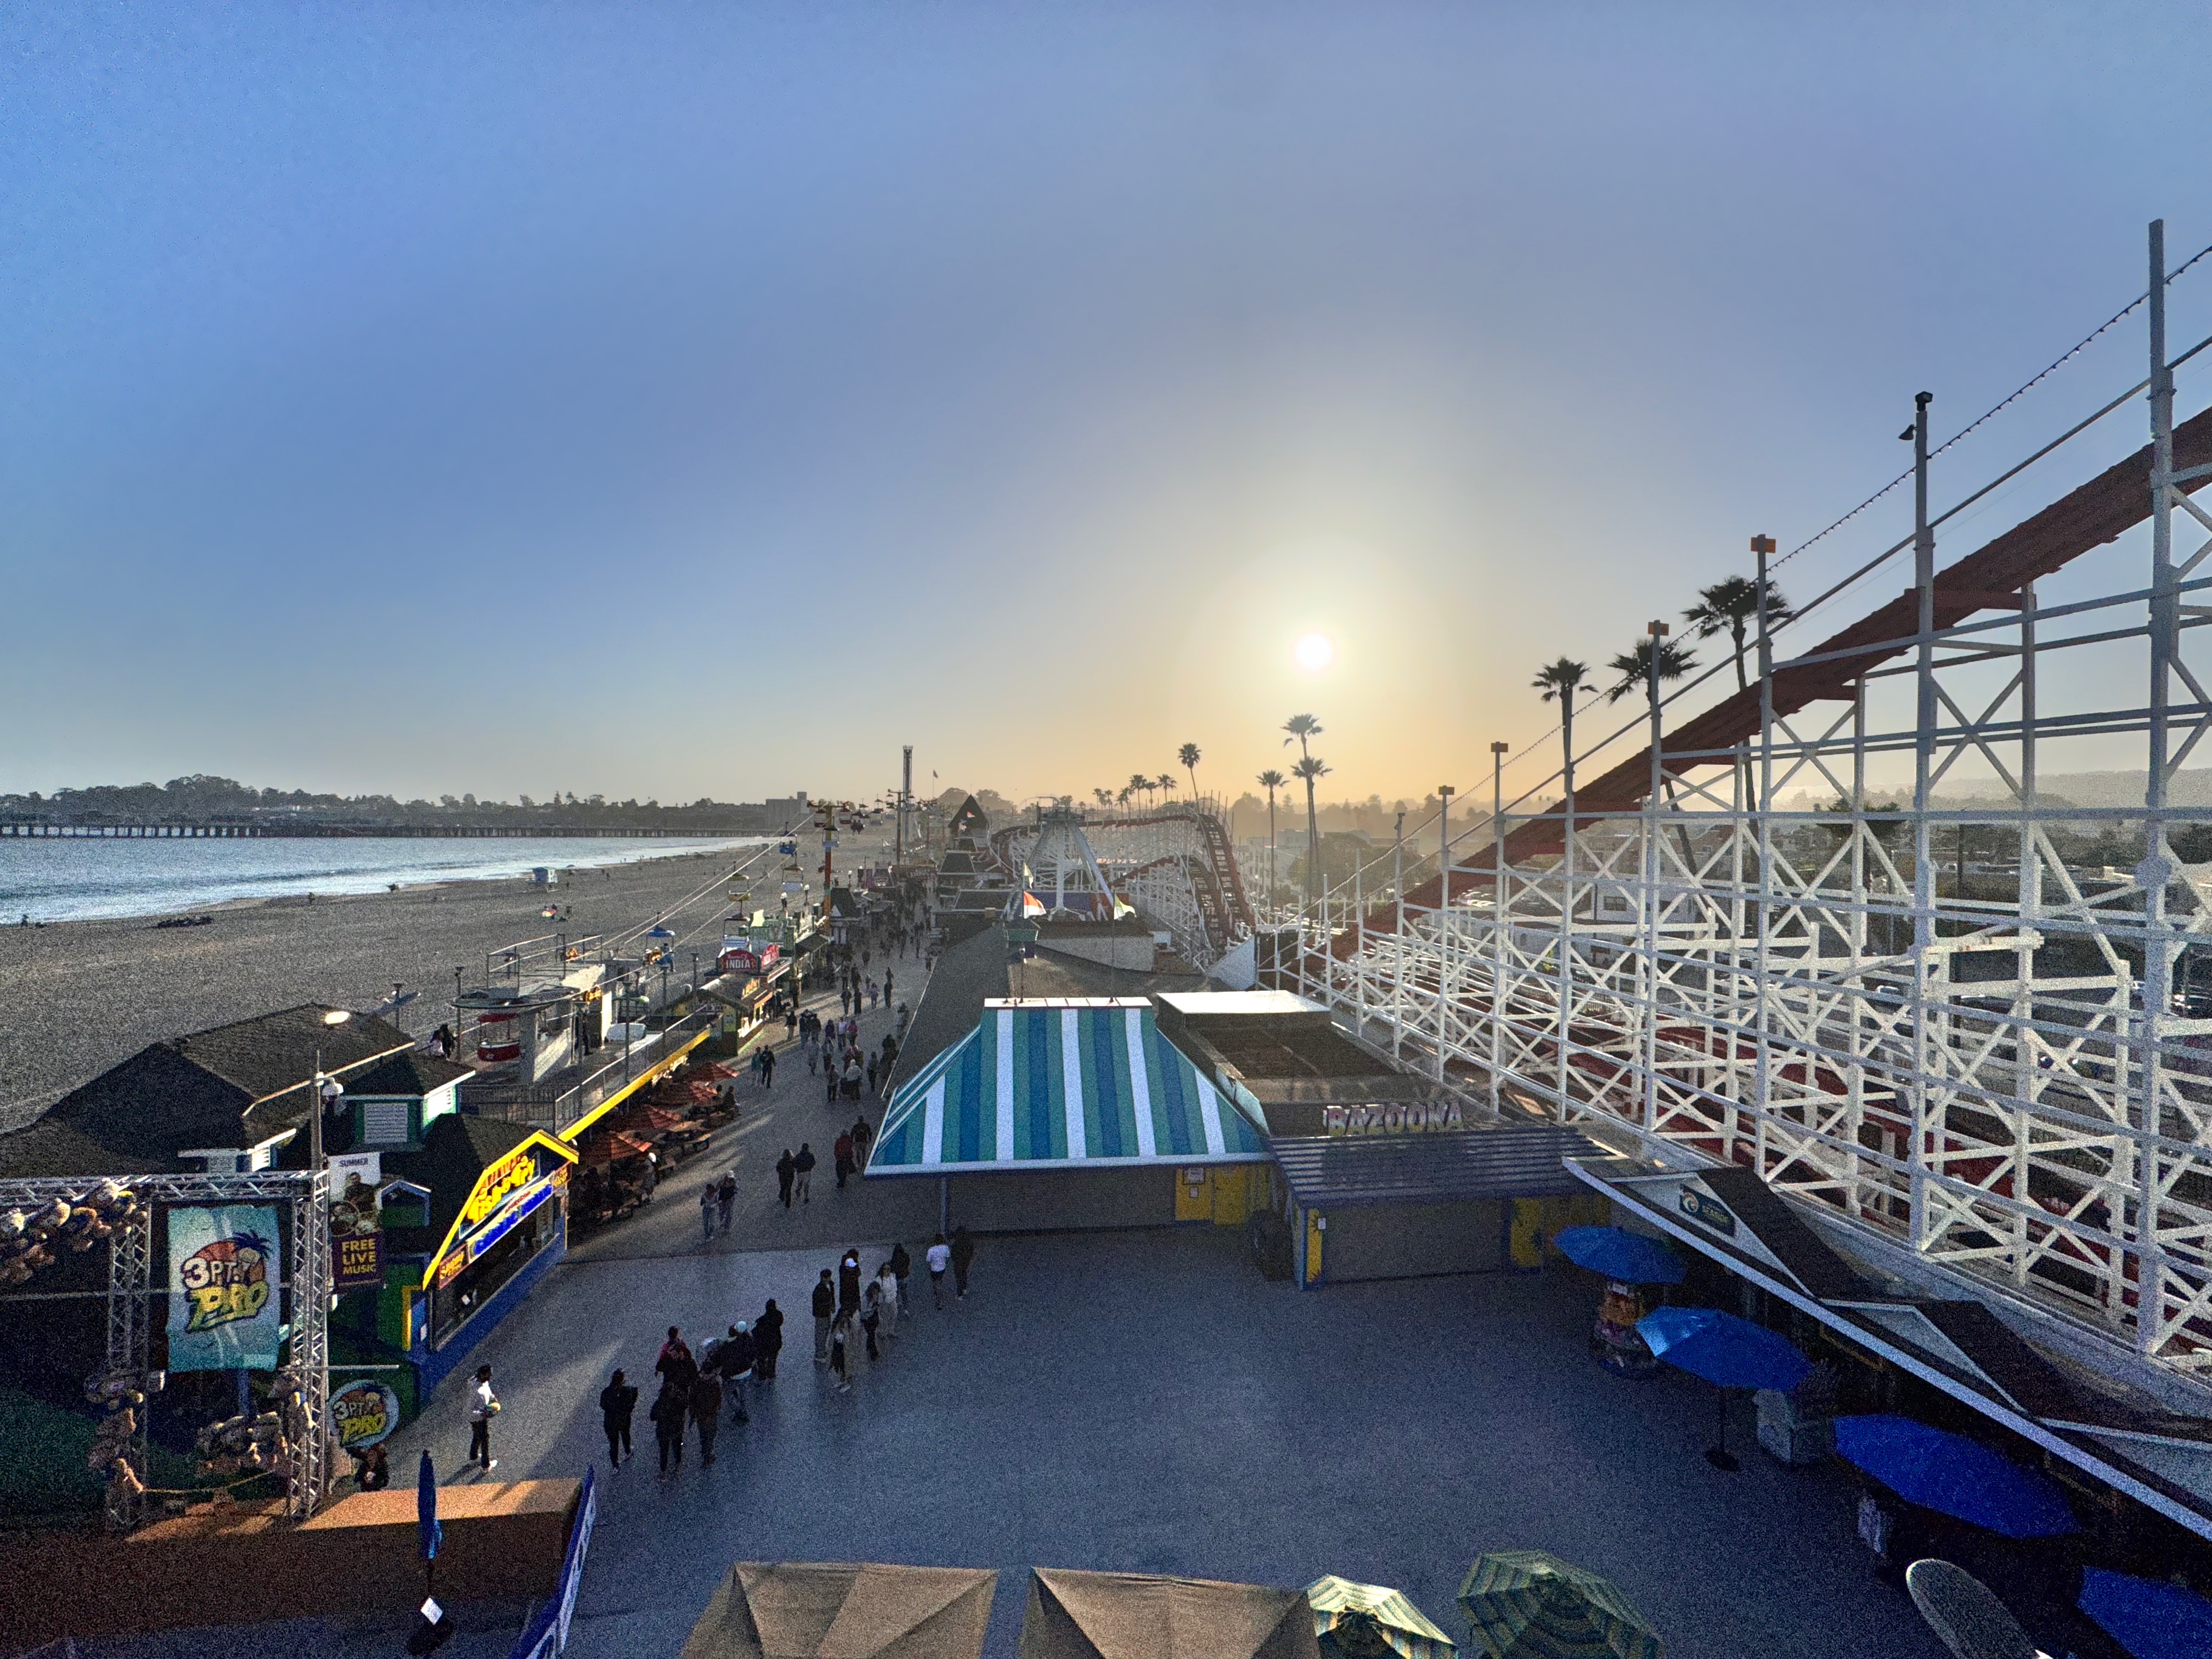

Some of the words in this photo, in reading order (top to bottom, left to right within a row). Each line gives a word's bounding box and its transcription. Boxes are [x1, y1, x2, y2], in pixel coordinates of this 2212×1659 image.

[726, 959, 751, 969] INDIA
[1327, 1101, 1464, 1136] BAZOOKA
[340, 1157, 368, 1167] SUMMER
[342, 1238, 376, 1251] FREE
[342, 1251, 376, 1265] LIVE
[342, 1264, 376, 1275] MUSIC
[188, 1280, 269, 1330] PRO
[338, 1412, 386, 1444] PRO
